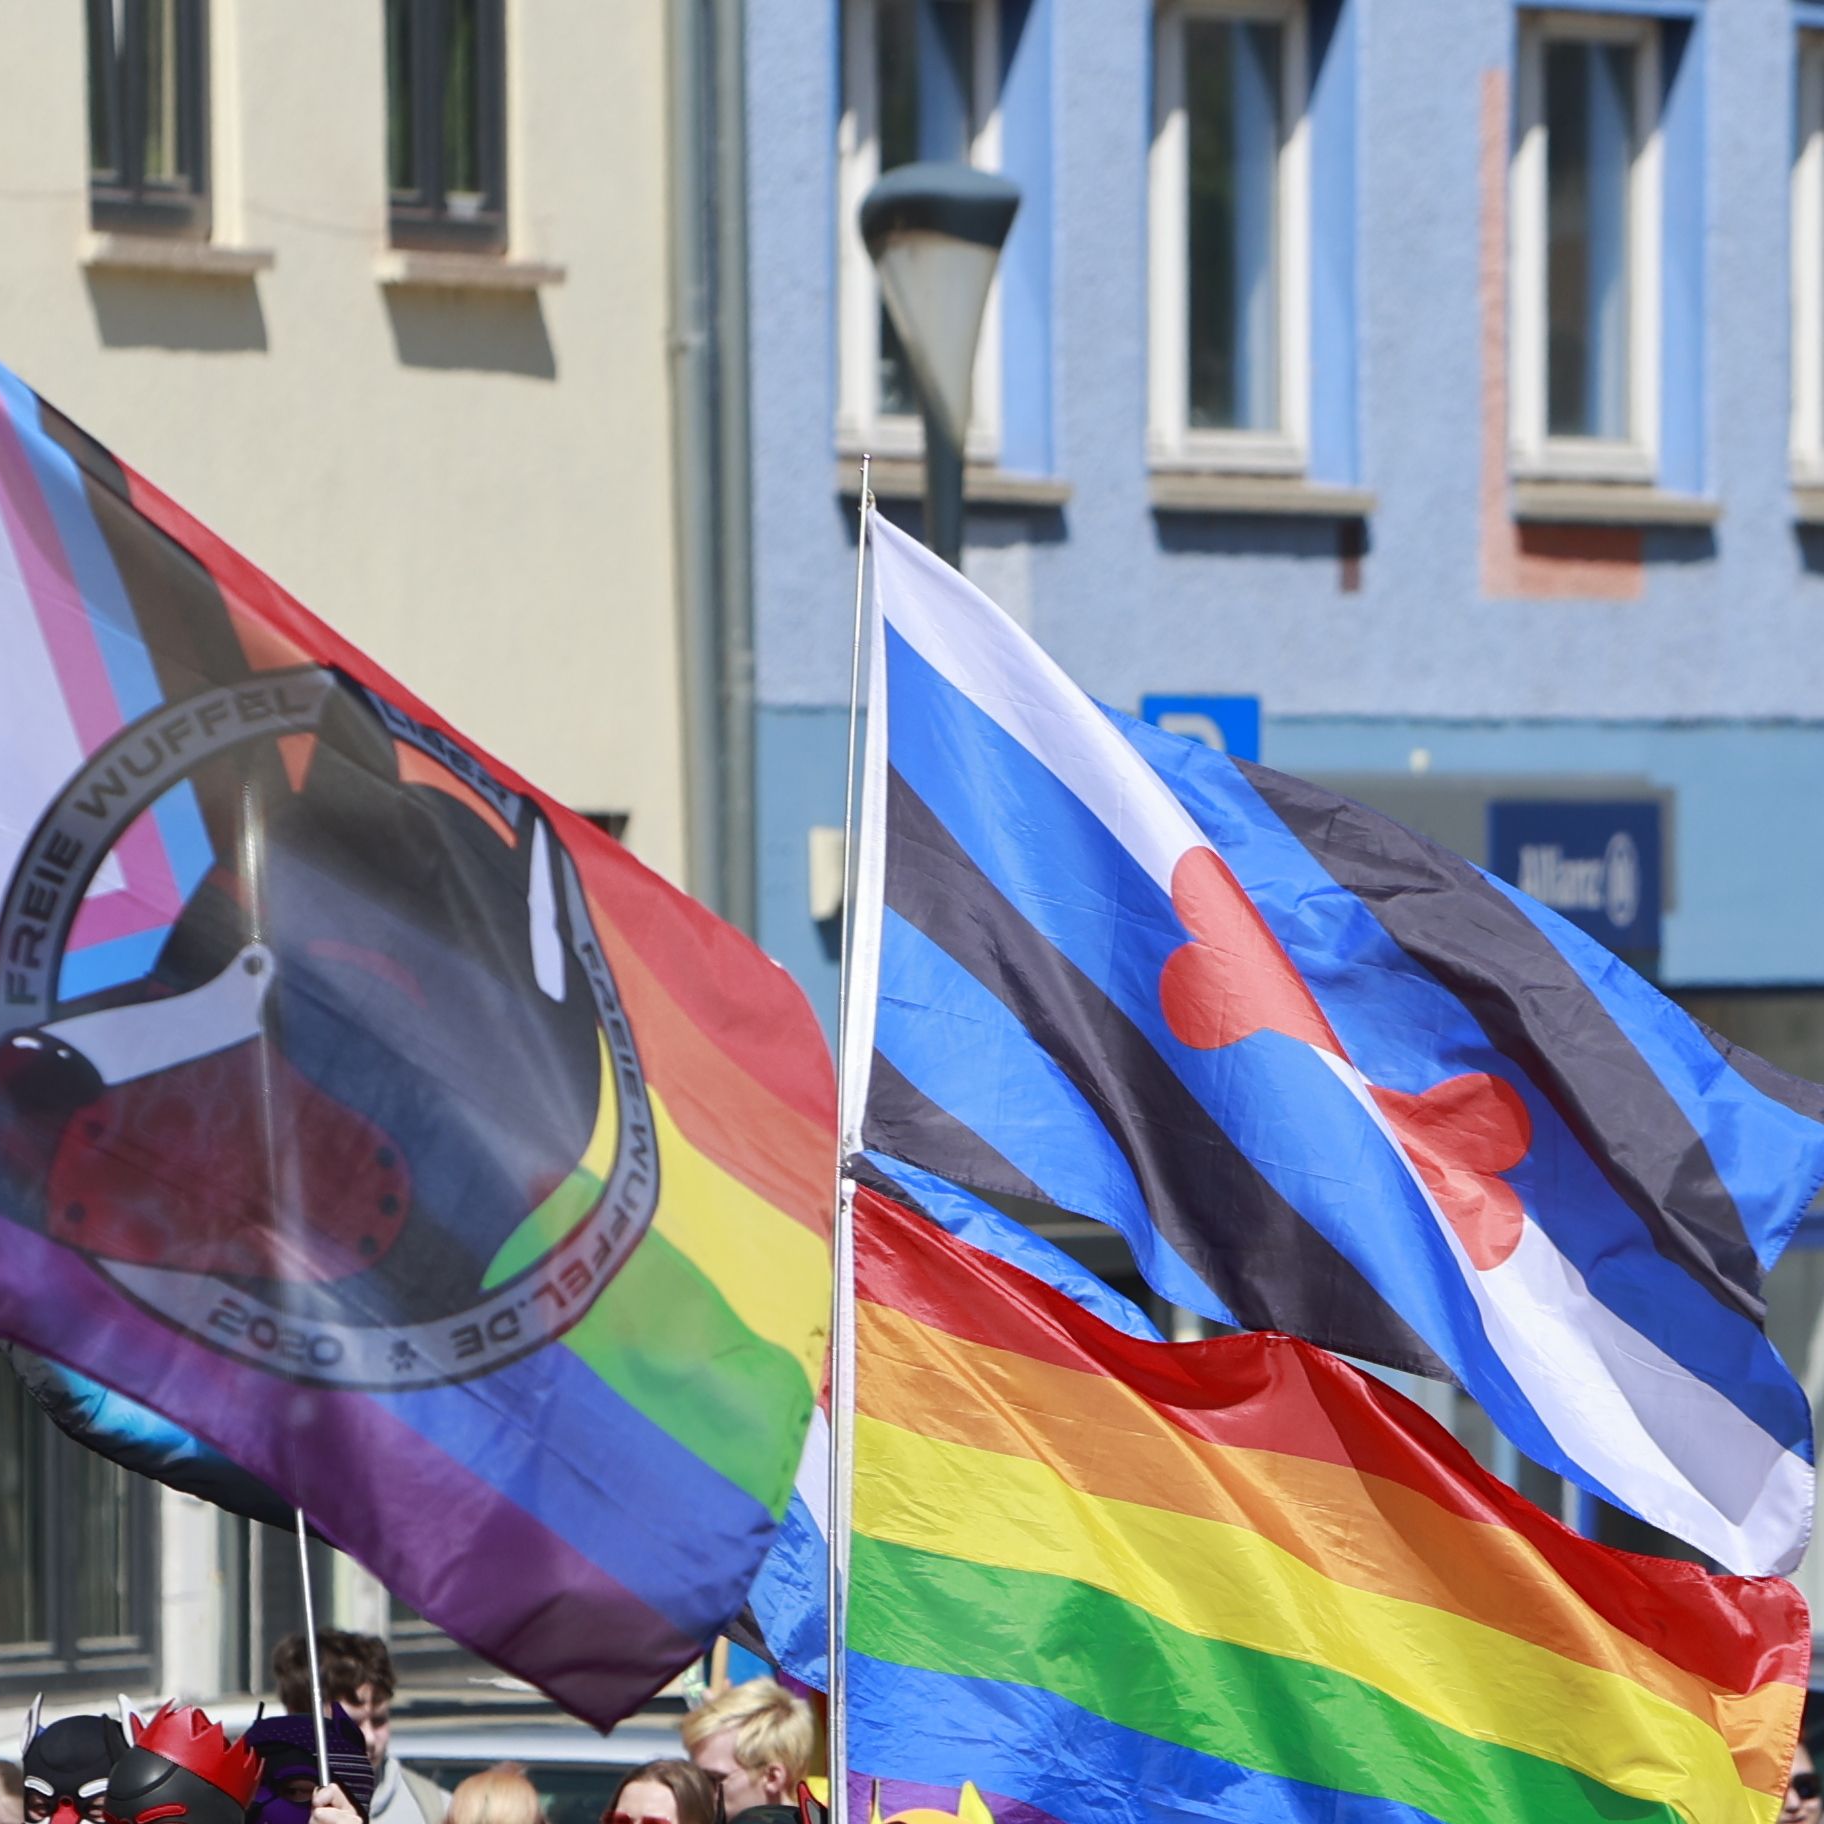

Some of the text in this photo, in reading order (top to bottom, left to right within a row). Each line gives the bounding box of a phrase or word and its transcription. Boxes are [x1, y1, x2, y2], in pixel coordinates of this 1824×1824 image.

[5, 829, 83, 1006] FREIE
[78, 687, 311, 819] WUFFEL
[208, 1297, 344, 1367] 2020
